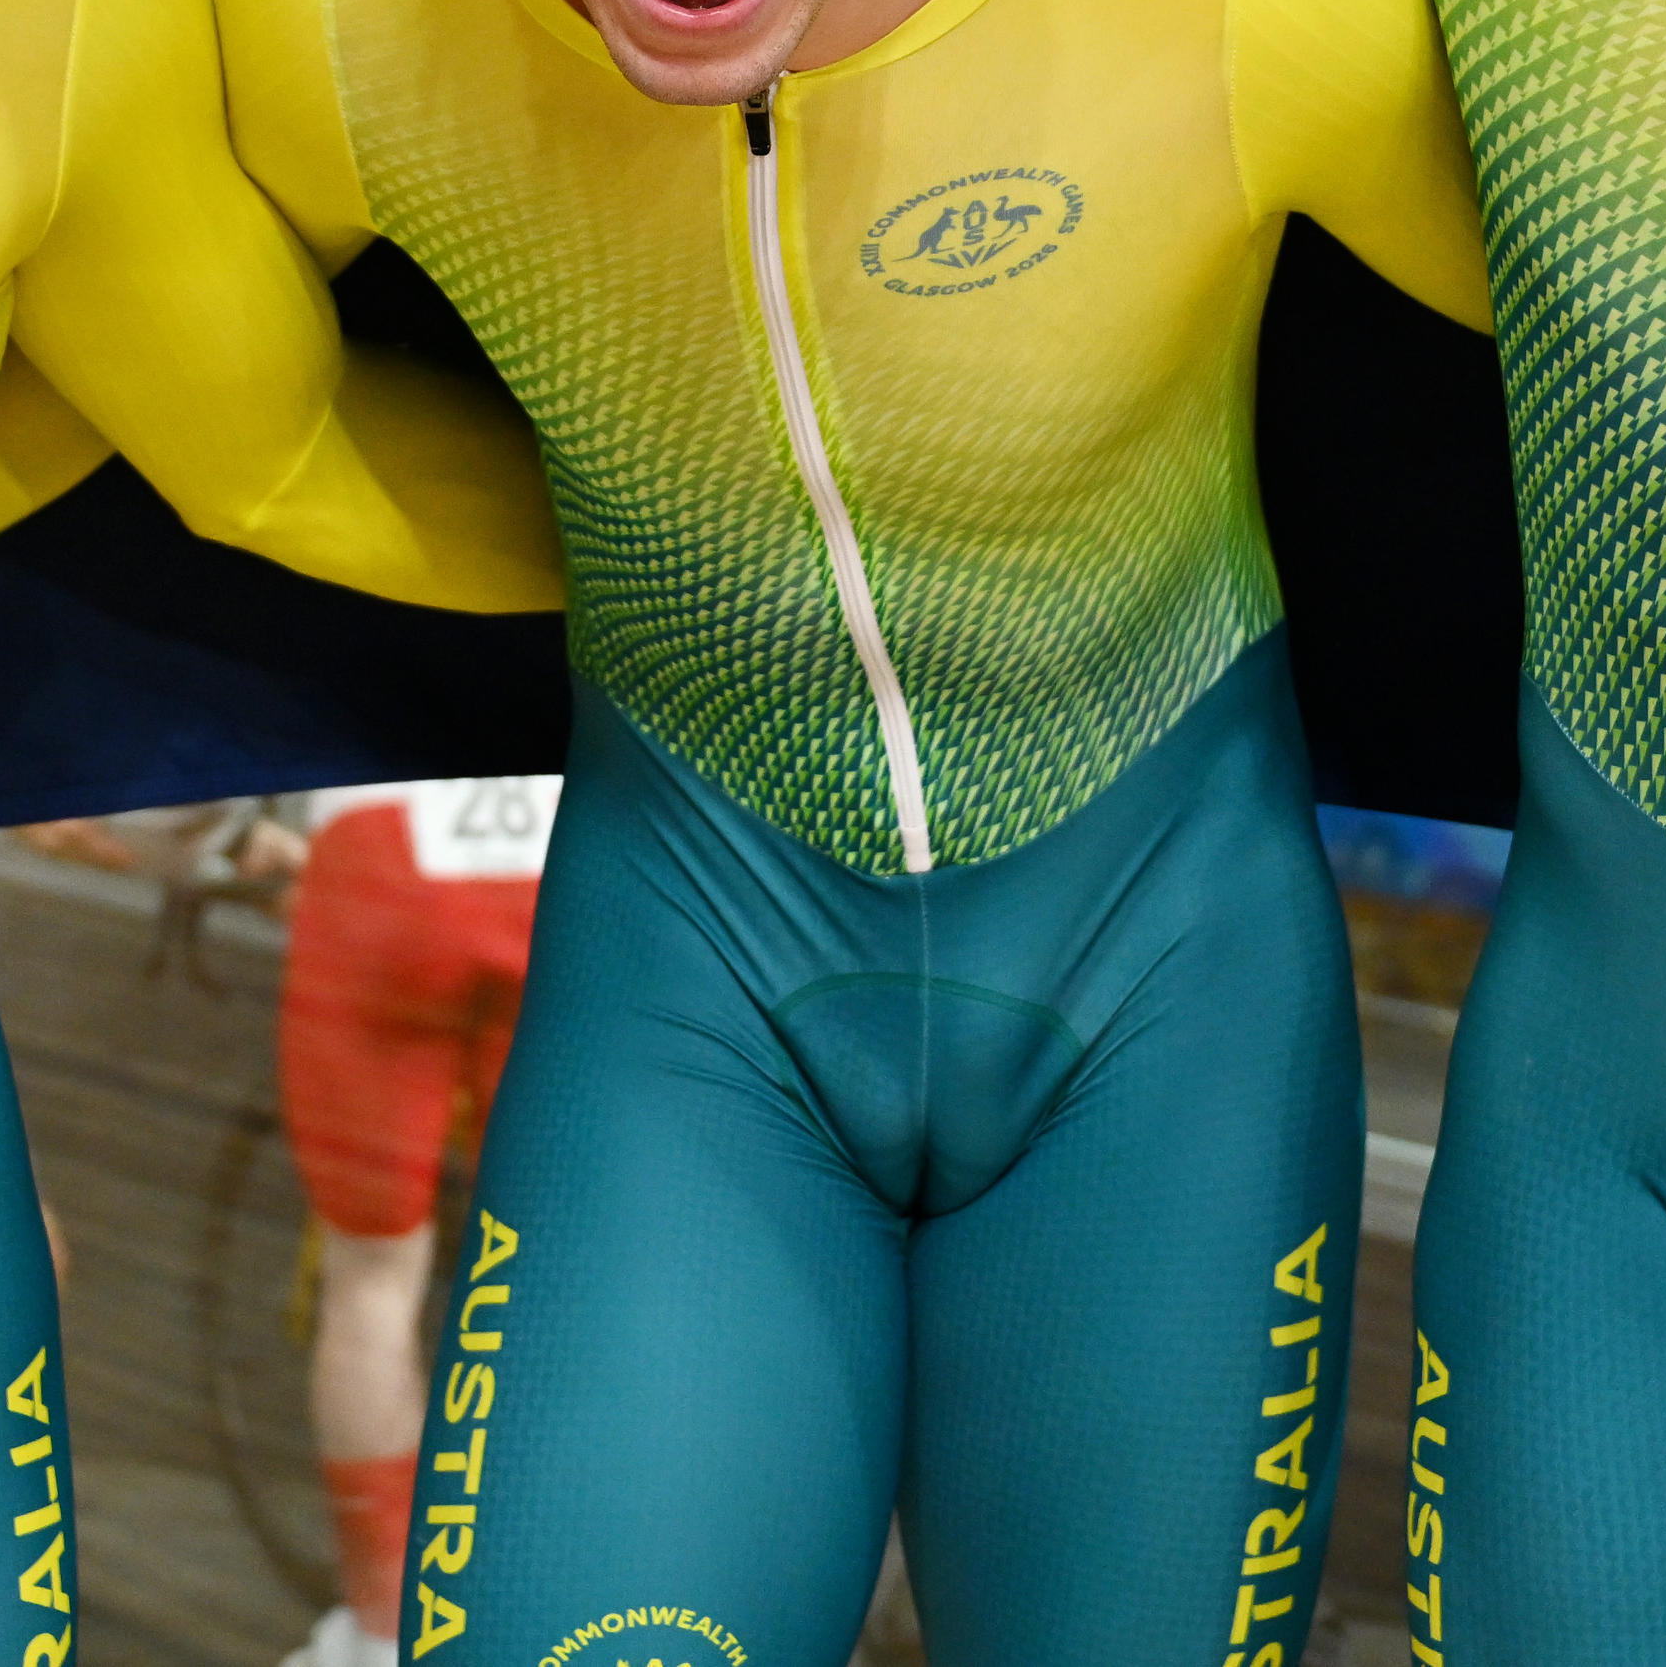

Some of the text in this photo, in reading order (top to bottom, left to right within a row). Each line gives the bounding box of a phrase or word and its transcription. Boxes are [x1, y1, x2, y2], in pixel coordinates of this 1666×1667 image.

[867, 167, 1067, 238] COMMONWEALTH
[1058, 184, 1085, 234] GAMES
[883, 243, 1058, 296] GLASGOW 2026
[412, 1209, 519, 1660] AUSTRA
